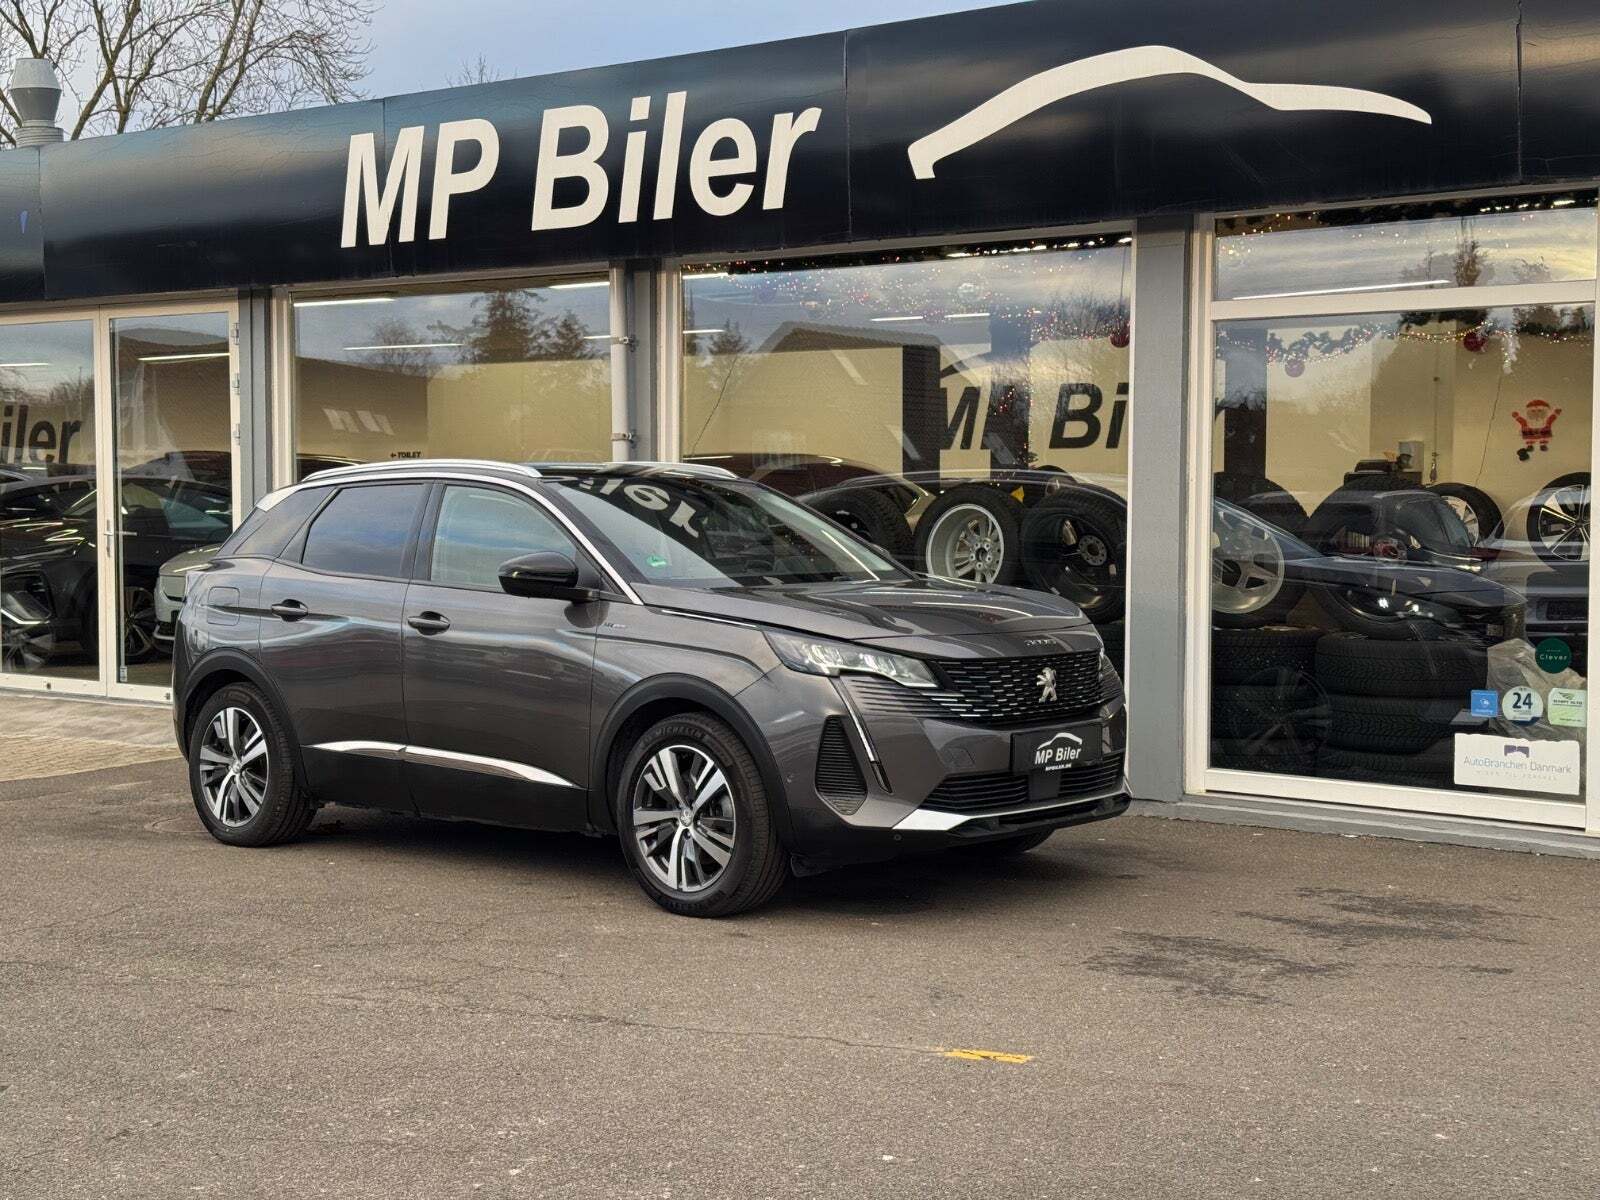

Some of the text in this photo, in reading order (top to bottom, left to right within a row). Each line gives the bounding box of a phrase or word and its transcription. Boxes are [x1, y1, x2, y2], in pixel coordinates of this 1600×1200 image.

[340, 91, 822, 249] MP Biler
[397, 451, 422, 459] TOILET
[1512, 692, 1533, 710] 24
[1035, 746, 1082, 765] MP Biler
[1463, 756, 1572, 774] AutoBranchen Danmark
